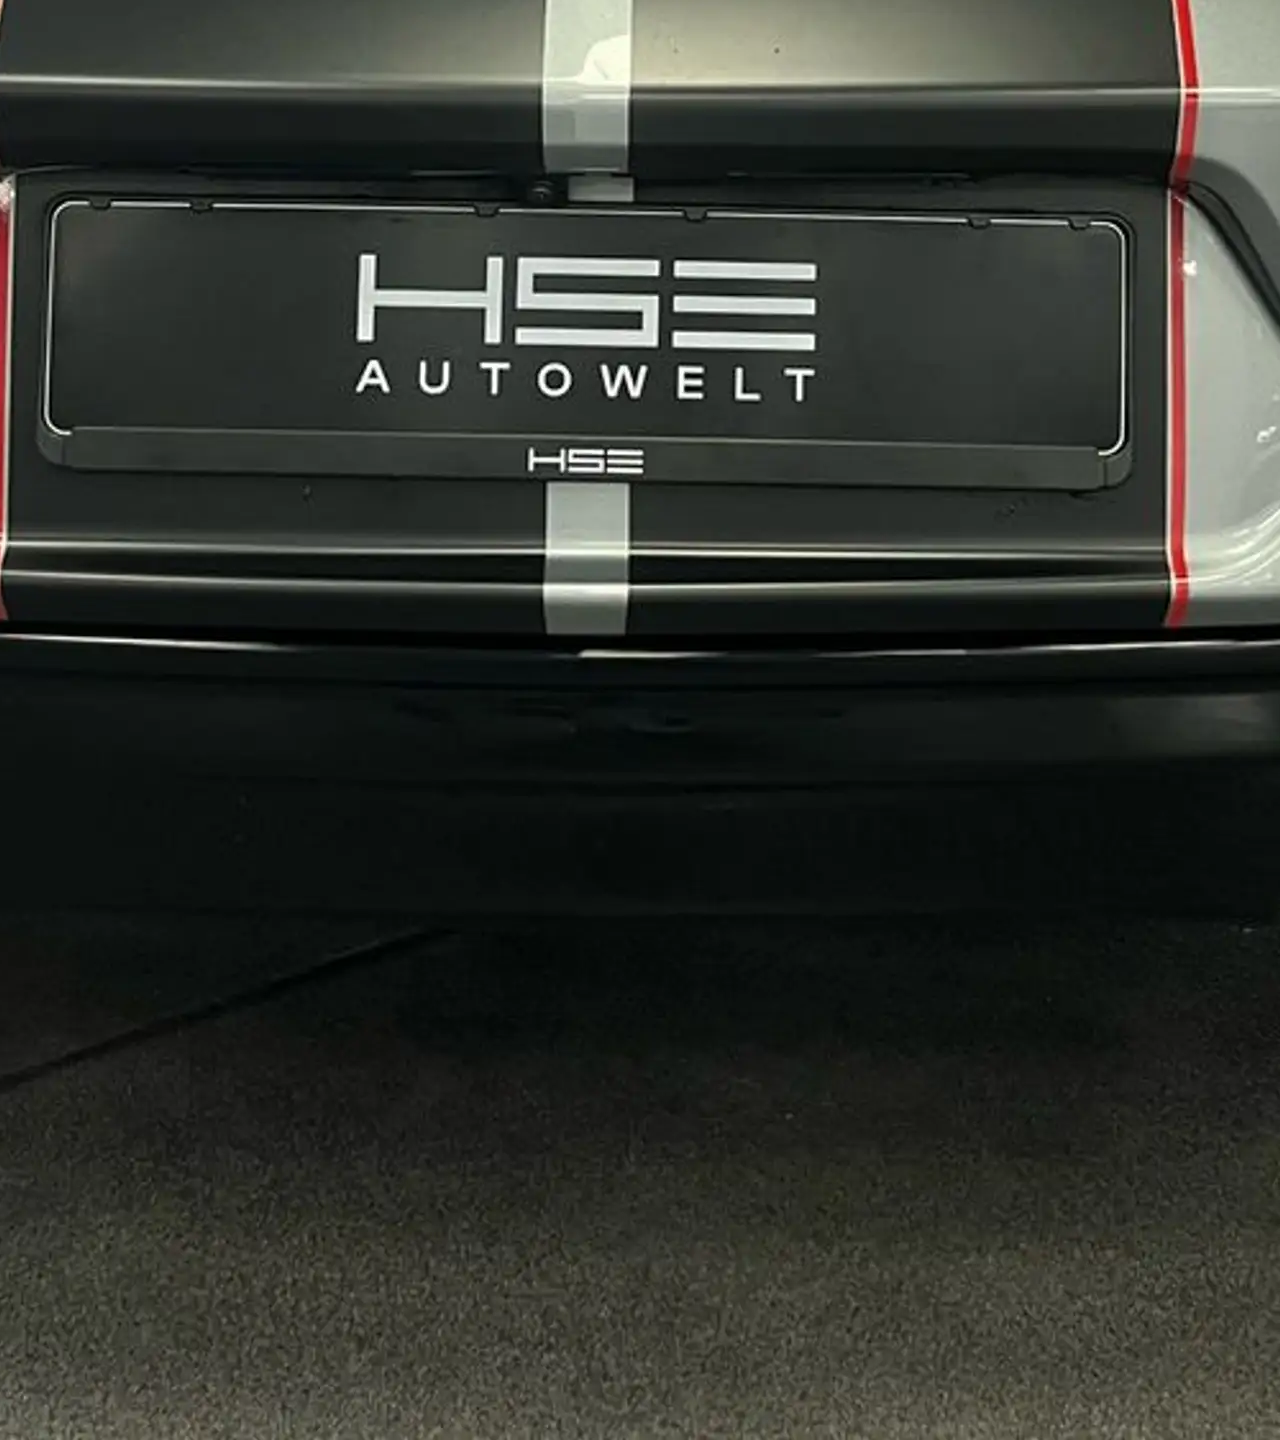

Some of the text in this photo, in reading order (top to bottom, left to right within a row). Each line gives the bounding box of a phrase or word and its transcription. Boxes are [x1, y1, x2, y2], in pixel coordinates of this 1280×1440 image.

[356, 253, 818, 352] HSE
[355, 359, 817, 402] AUTOWELT
[527, 447, 644, 475] HSE
